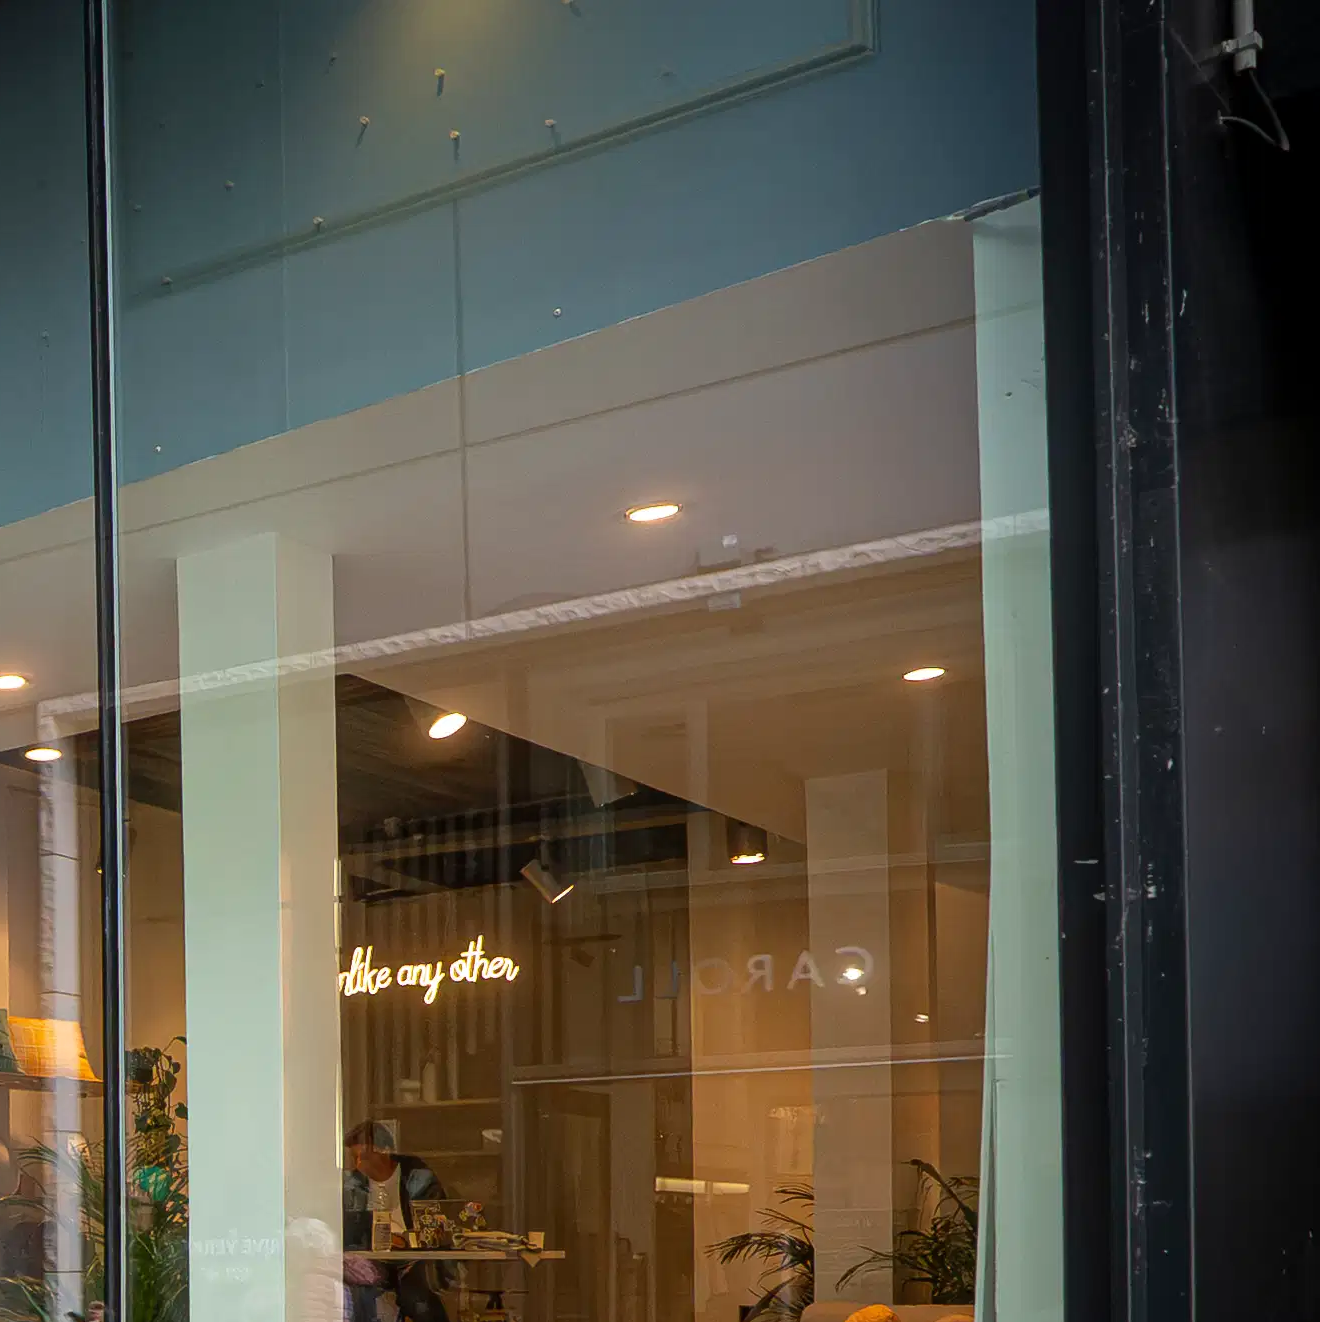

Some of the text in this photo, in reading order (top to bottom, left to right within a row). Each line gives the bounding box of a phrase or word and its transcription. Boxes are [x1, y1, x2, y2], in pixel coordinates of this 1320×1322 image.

[338, 934, 520, 1005] nlike any other
